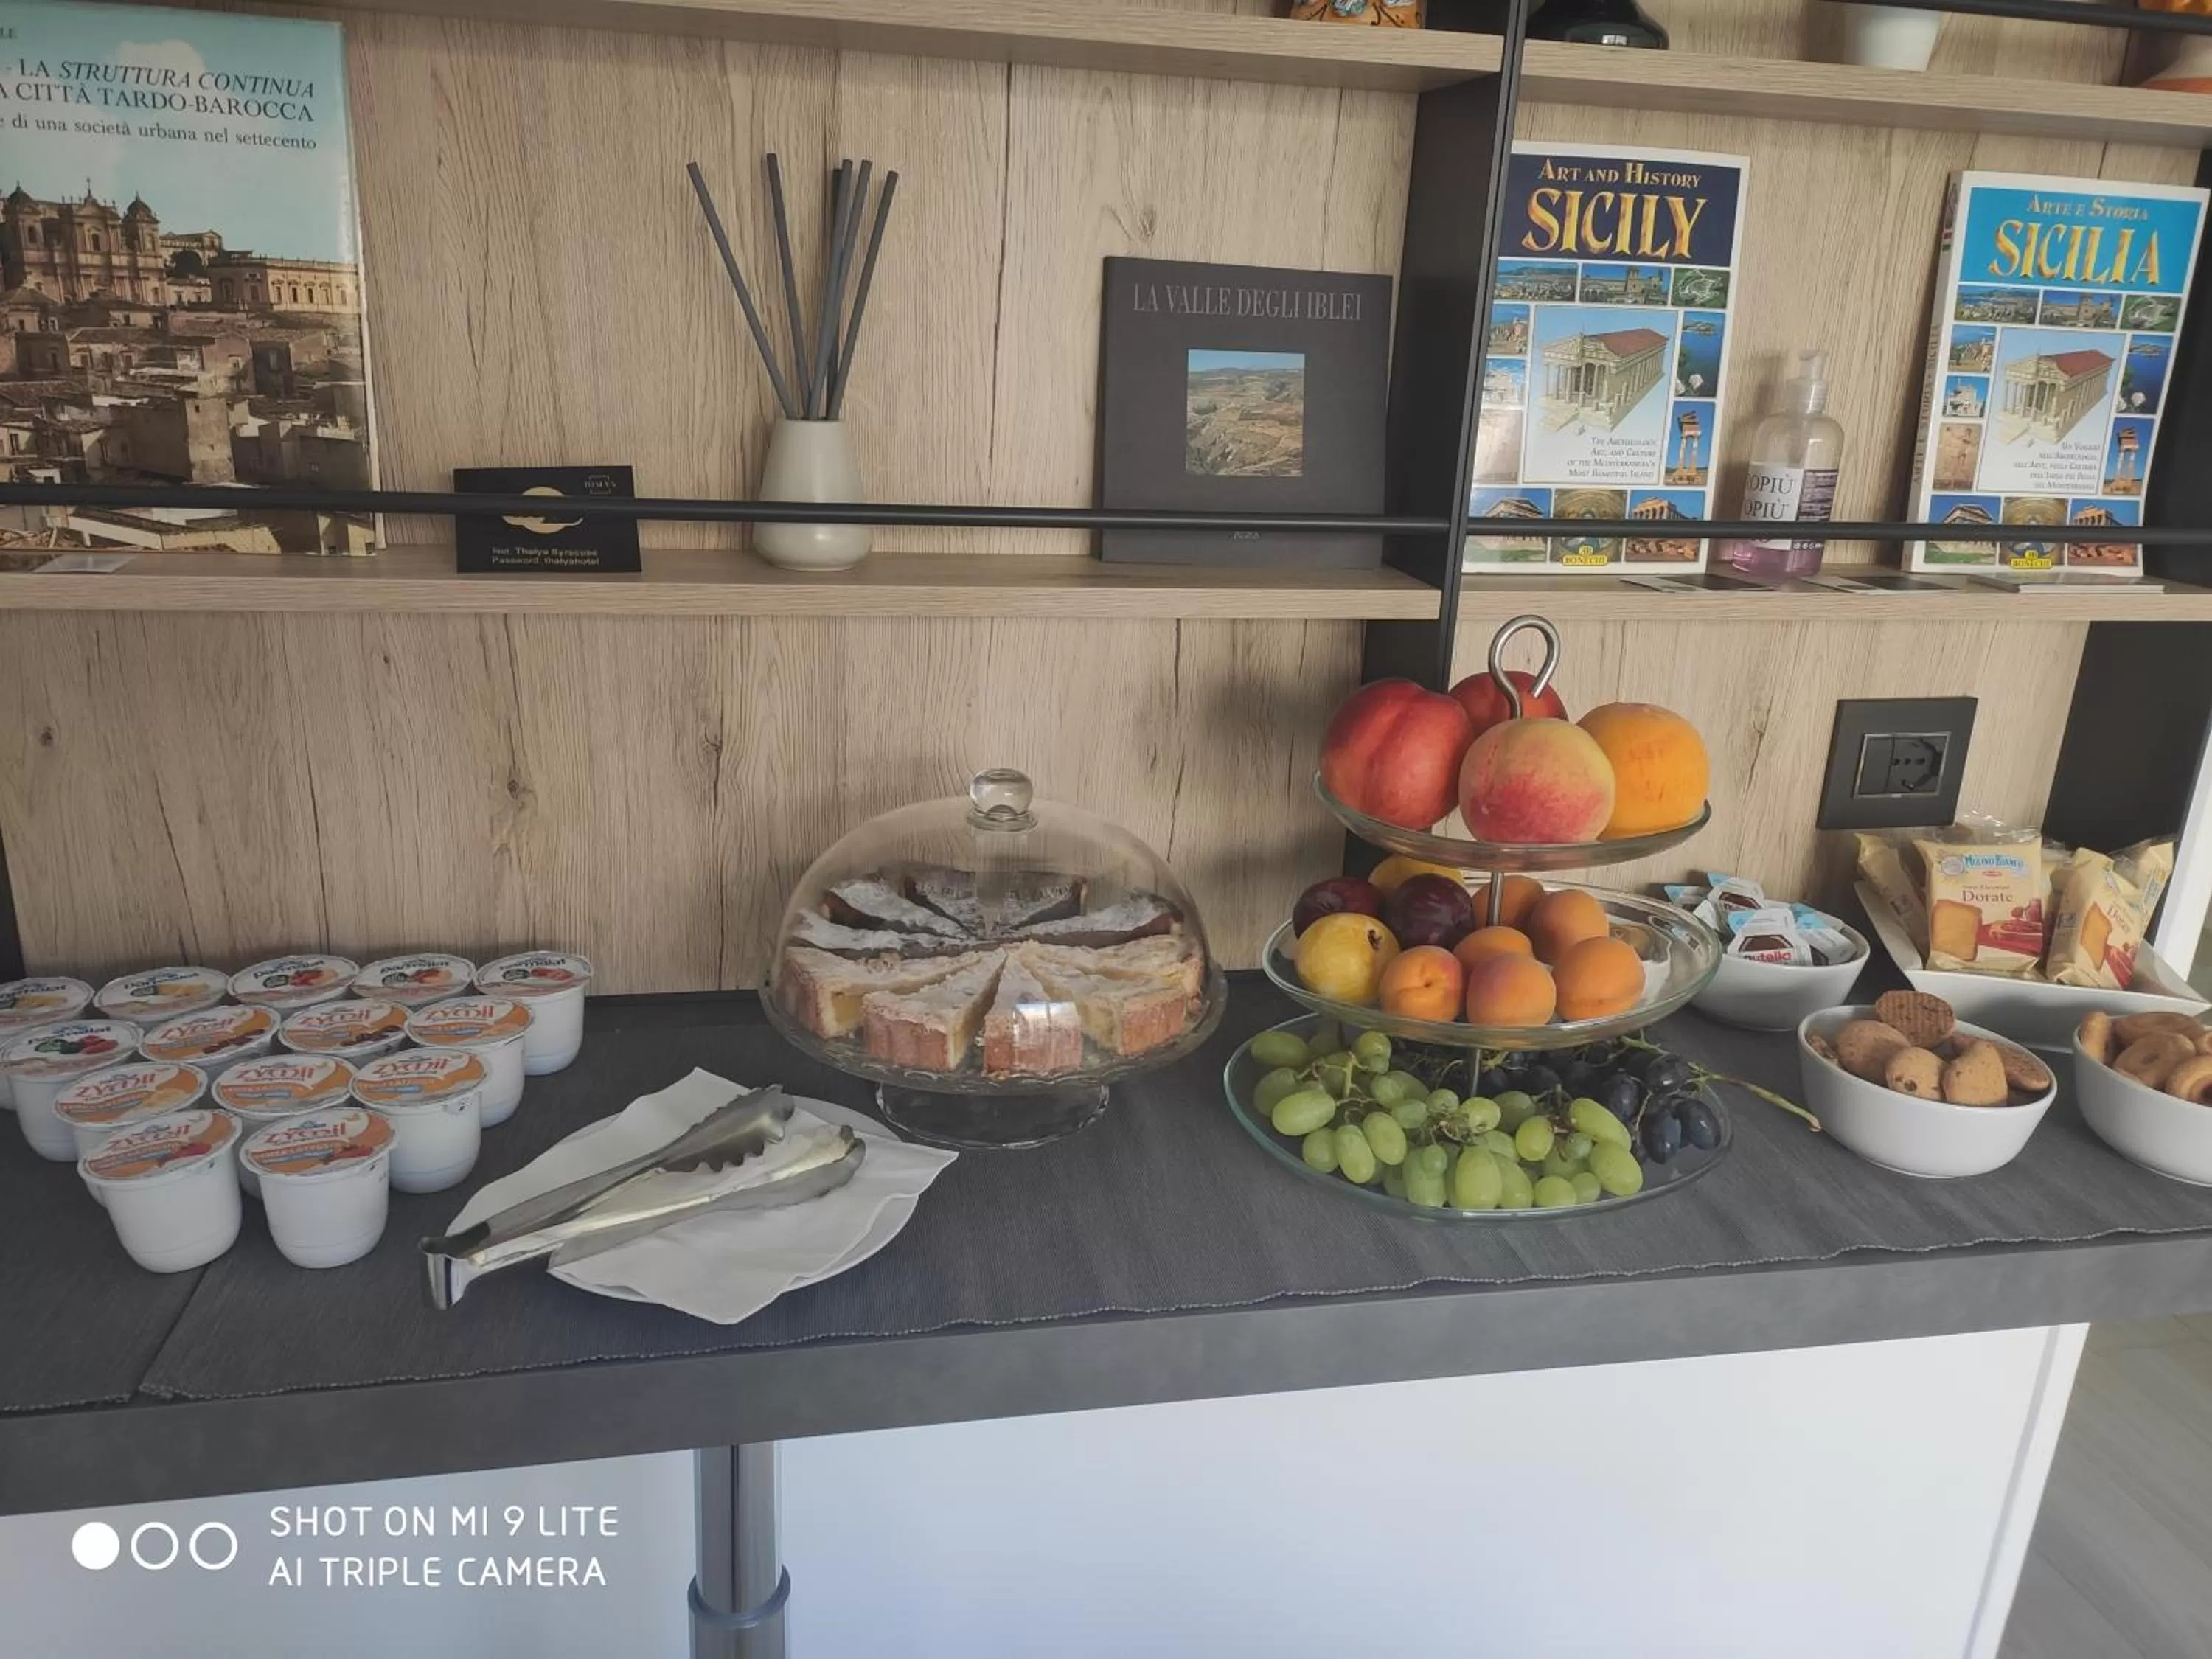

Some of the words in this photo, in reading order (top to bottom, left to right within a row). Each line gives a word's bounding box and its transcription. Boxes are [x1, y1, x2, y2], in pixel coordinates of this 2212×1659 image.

[20, 58, 50, 77] LA
[59, 60, 190, 88] STRUTTURA
[198, 72, 314, 99] CONTINUA
[16, 82, 91, 105] CITTÀ
[97, 87, 314, 122] TARDO-BAROCCA
[12, 112, 28, 129] di
[36, 119, 66, 131] una
[74, 119, 131, 136] società
[139, 122, 197, 141] urbana
[204, 127, 229, 143] nel
[235, 132, 317, 150] settecento
[1537, 158, 1581, 182] ART
[1585, 167, 1619, 184] AND
[1624, 161, 1703, 189] HISTORY
[1521, 187, 1708, 260] SICILY
[2027, 193, 2071, 214] ARTE
[2076, 203, 2085, 216] E
[2088, 196, 2149, 221] STORIA
[1988, 219, 2160, 285] SICILIA
[1133, 282, 1158, 312] LA
[1165, 284, 1231, 315] VALLE
[1237, 288, 1298, 319] DEGLI
[1307, 291, 1363, 320] IBLEI
[1962, 890, 2014, 902] Dorate
